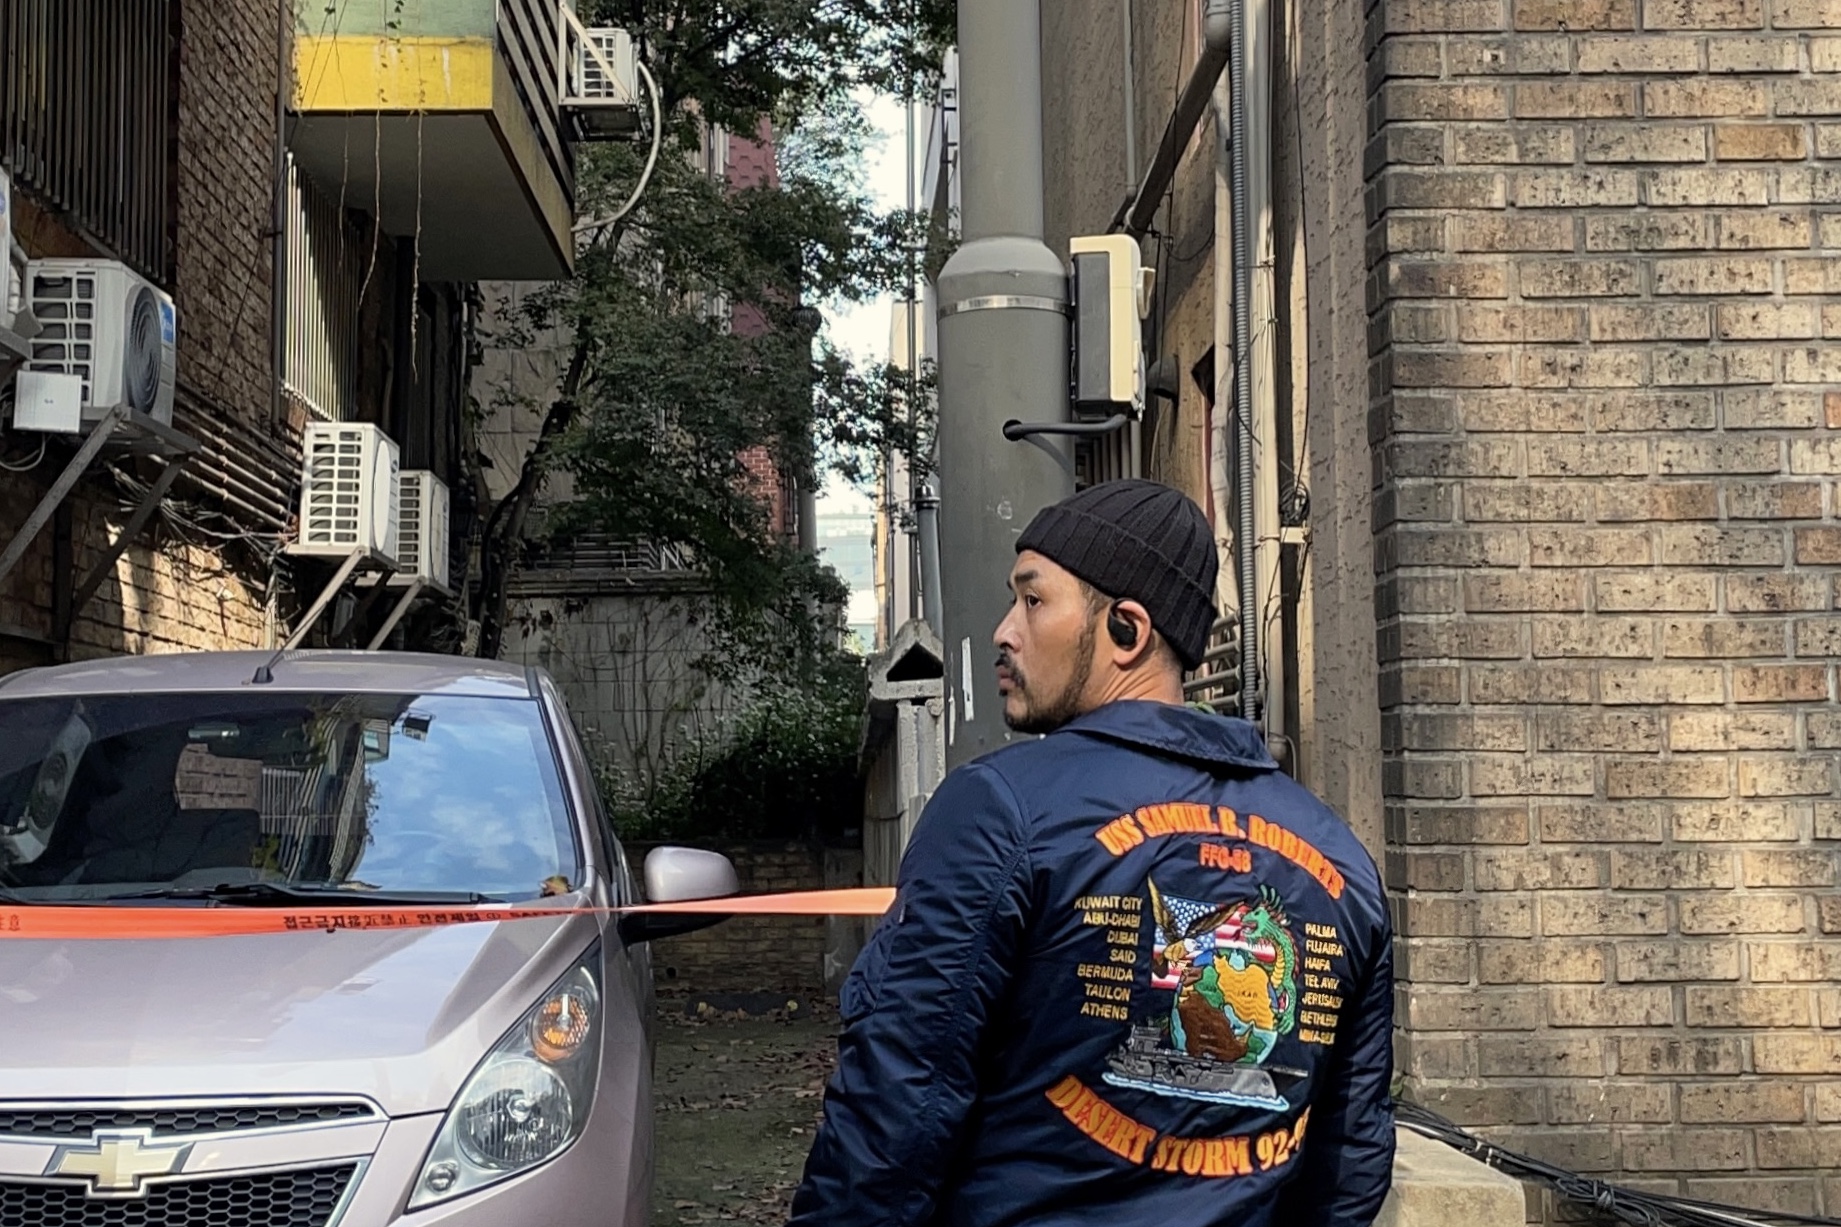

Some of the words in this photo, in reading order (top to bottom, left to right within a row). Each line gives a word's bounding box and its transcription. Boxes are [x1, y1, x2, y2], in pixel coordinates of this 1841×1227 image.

[1095, 813, 1144, 856] USS
[1136, 803, 1219, 837] SAMUEL
[1248, 814, 1345, 899] ROBERTS
[1074, 896, 1121, 910] KUWAIT
[1122, 897, 1143, 910] CITY
[1083, 911, 1141, 928] ABU-DHABI
[1107, 930, 1139, 946] DUBAI
[1305, 923, 1337, 938] PALMA
[1110, 949, 1136, 963] SAID
[1077, 963, 1133, 982] BERMUDA
[1304, 957, 1331, 972] HAIFA
[1304, 974, 1319, 988] TEL
[1085, 983, 1131, 1002] TAULON
[1081, 1002, 1128, 1020] ATHENS
[1045, 1074, 1157, 1165] DESERT
[1151, 1136, 1253, 1176] STORM
